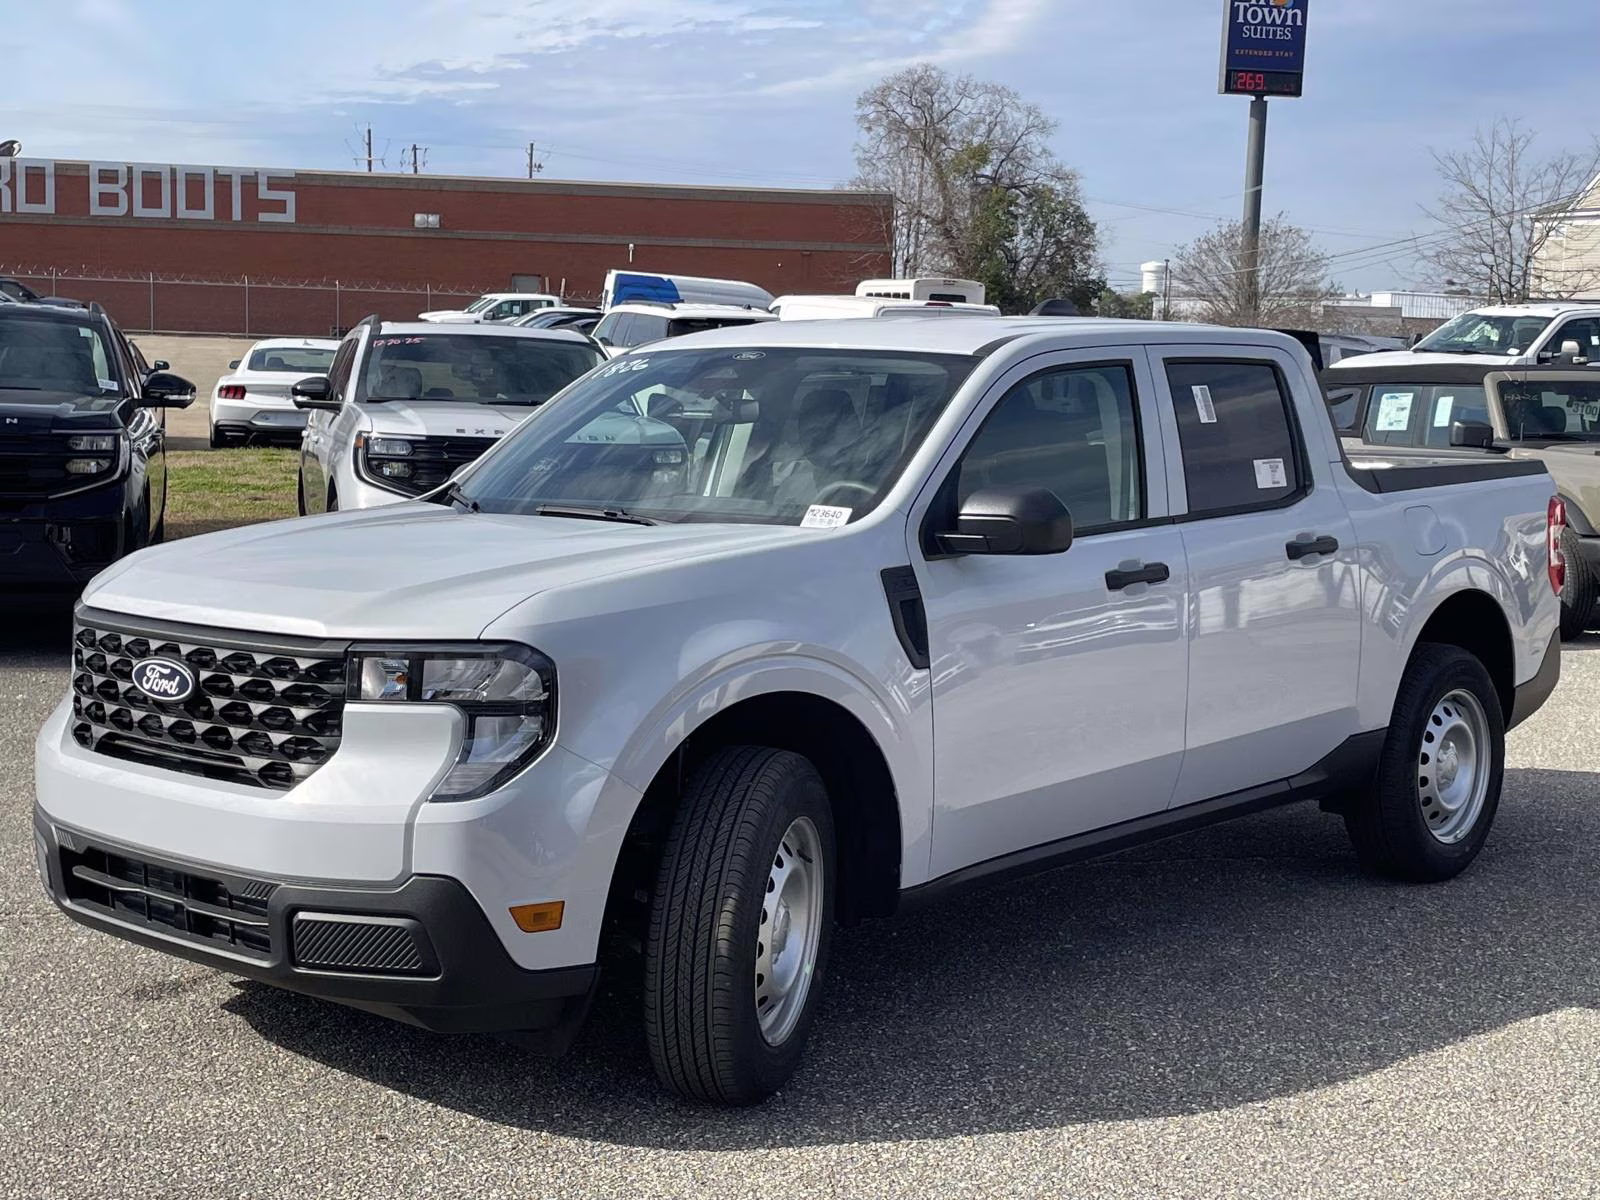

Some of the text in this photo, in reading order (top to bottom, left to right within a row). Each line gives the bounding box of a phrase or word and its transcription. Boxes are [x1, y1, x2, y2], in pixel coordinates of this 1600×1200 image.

[1234, 2, 1303, 26] Town
[1242, 25, 1292, 40] SUITES
[89, 160, 296, 224] BOOTS
[142, 664, 180, 695] Ford
